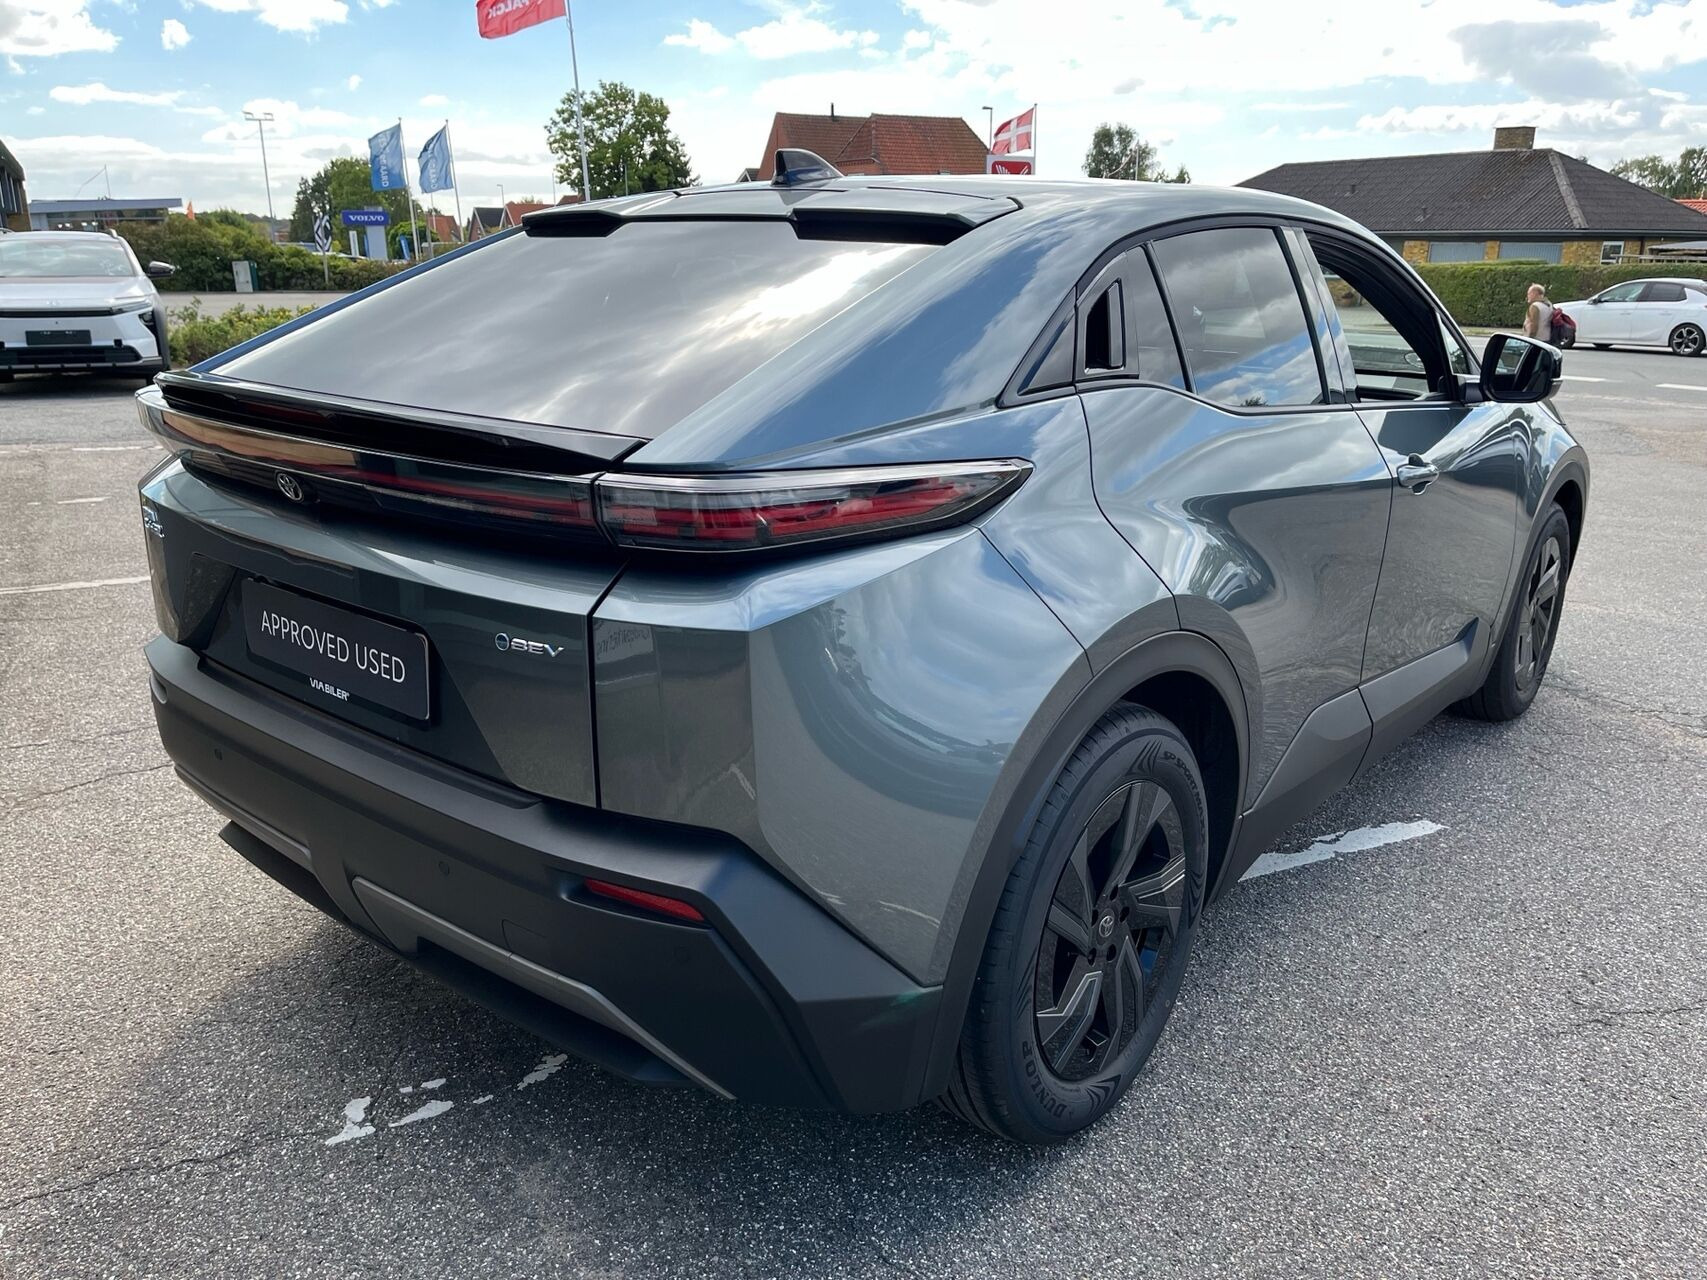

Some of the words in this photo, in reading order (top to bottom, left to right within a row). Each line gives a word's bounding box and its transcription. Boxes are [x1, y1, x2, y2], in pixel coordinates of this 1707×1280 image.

[348, 214, 385, 222] VOLVO
[261, 610, 349, 663] APPROVED
[355, 643, 406, 683] USED
[1174, 757, 1199, 791] SPORT
[1022, 1040, 1067, 1118] DUNLOP
